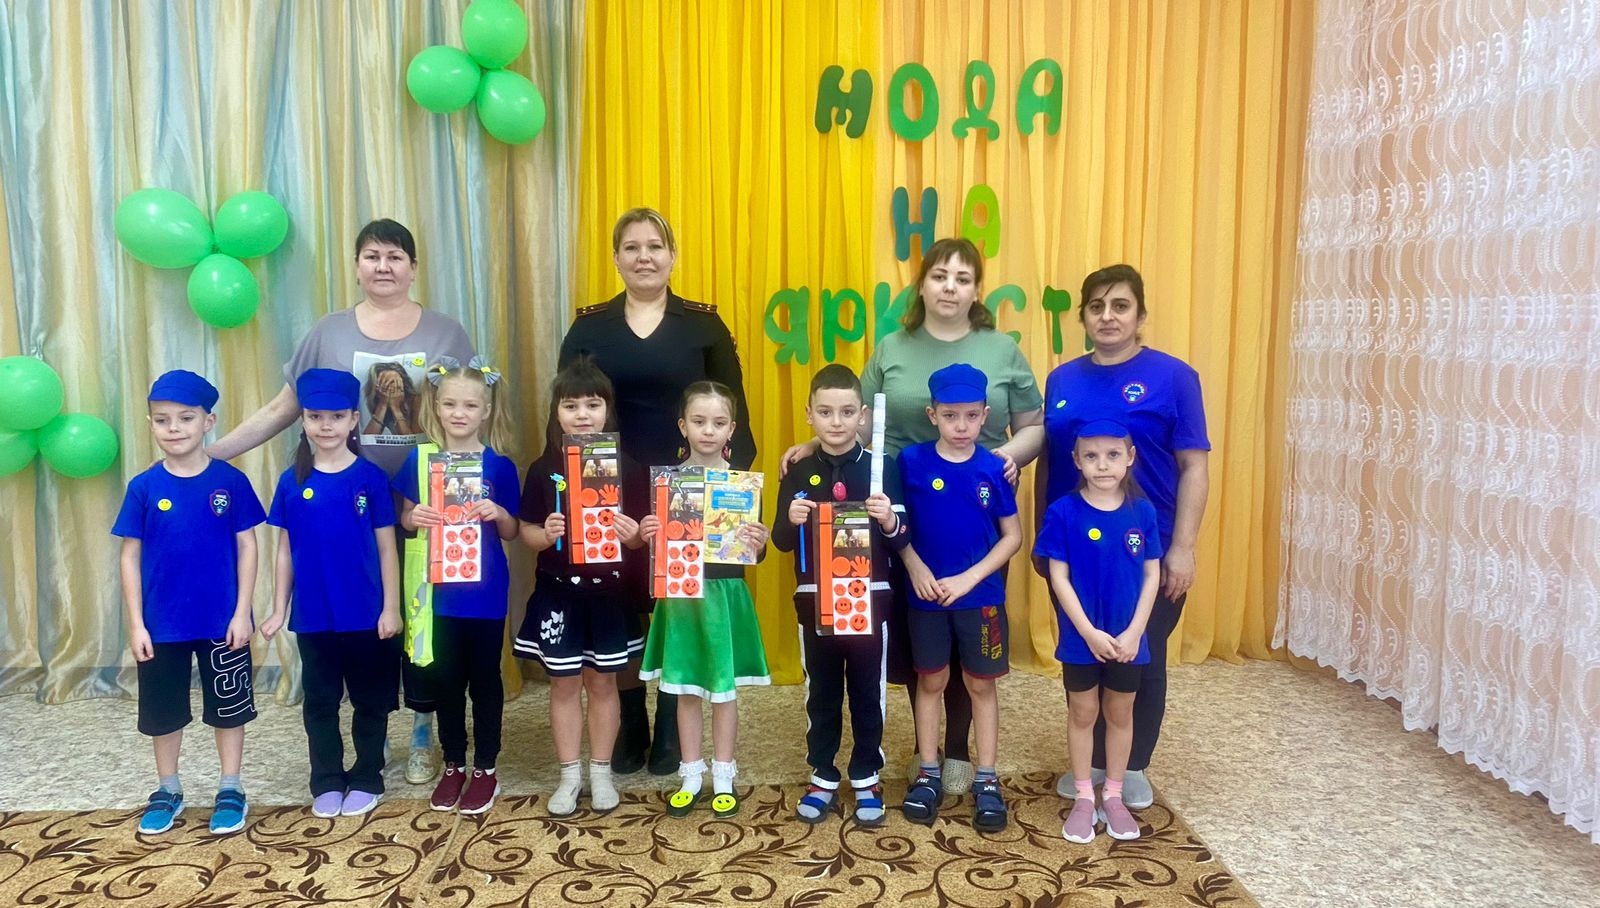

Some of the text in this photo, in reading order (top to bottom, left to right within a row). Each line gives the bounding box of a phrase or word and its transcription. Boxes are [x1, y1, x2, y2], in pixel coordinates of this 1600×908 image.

[815, 58, 1063, 141] МОДА
[892, 184, 1000, 262] НА
[764, 281, 1094, 365] ЯРКСТ
